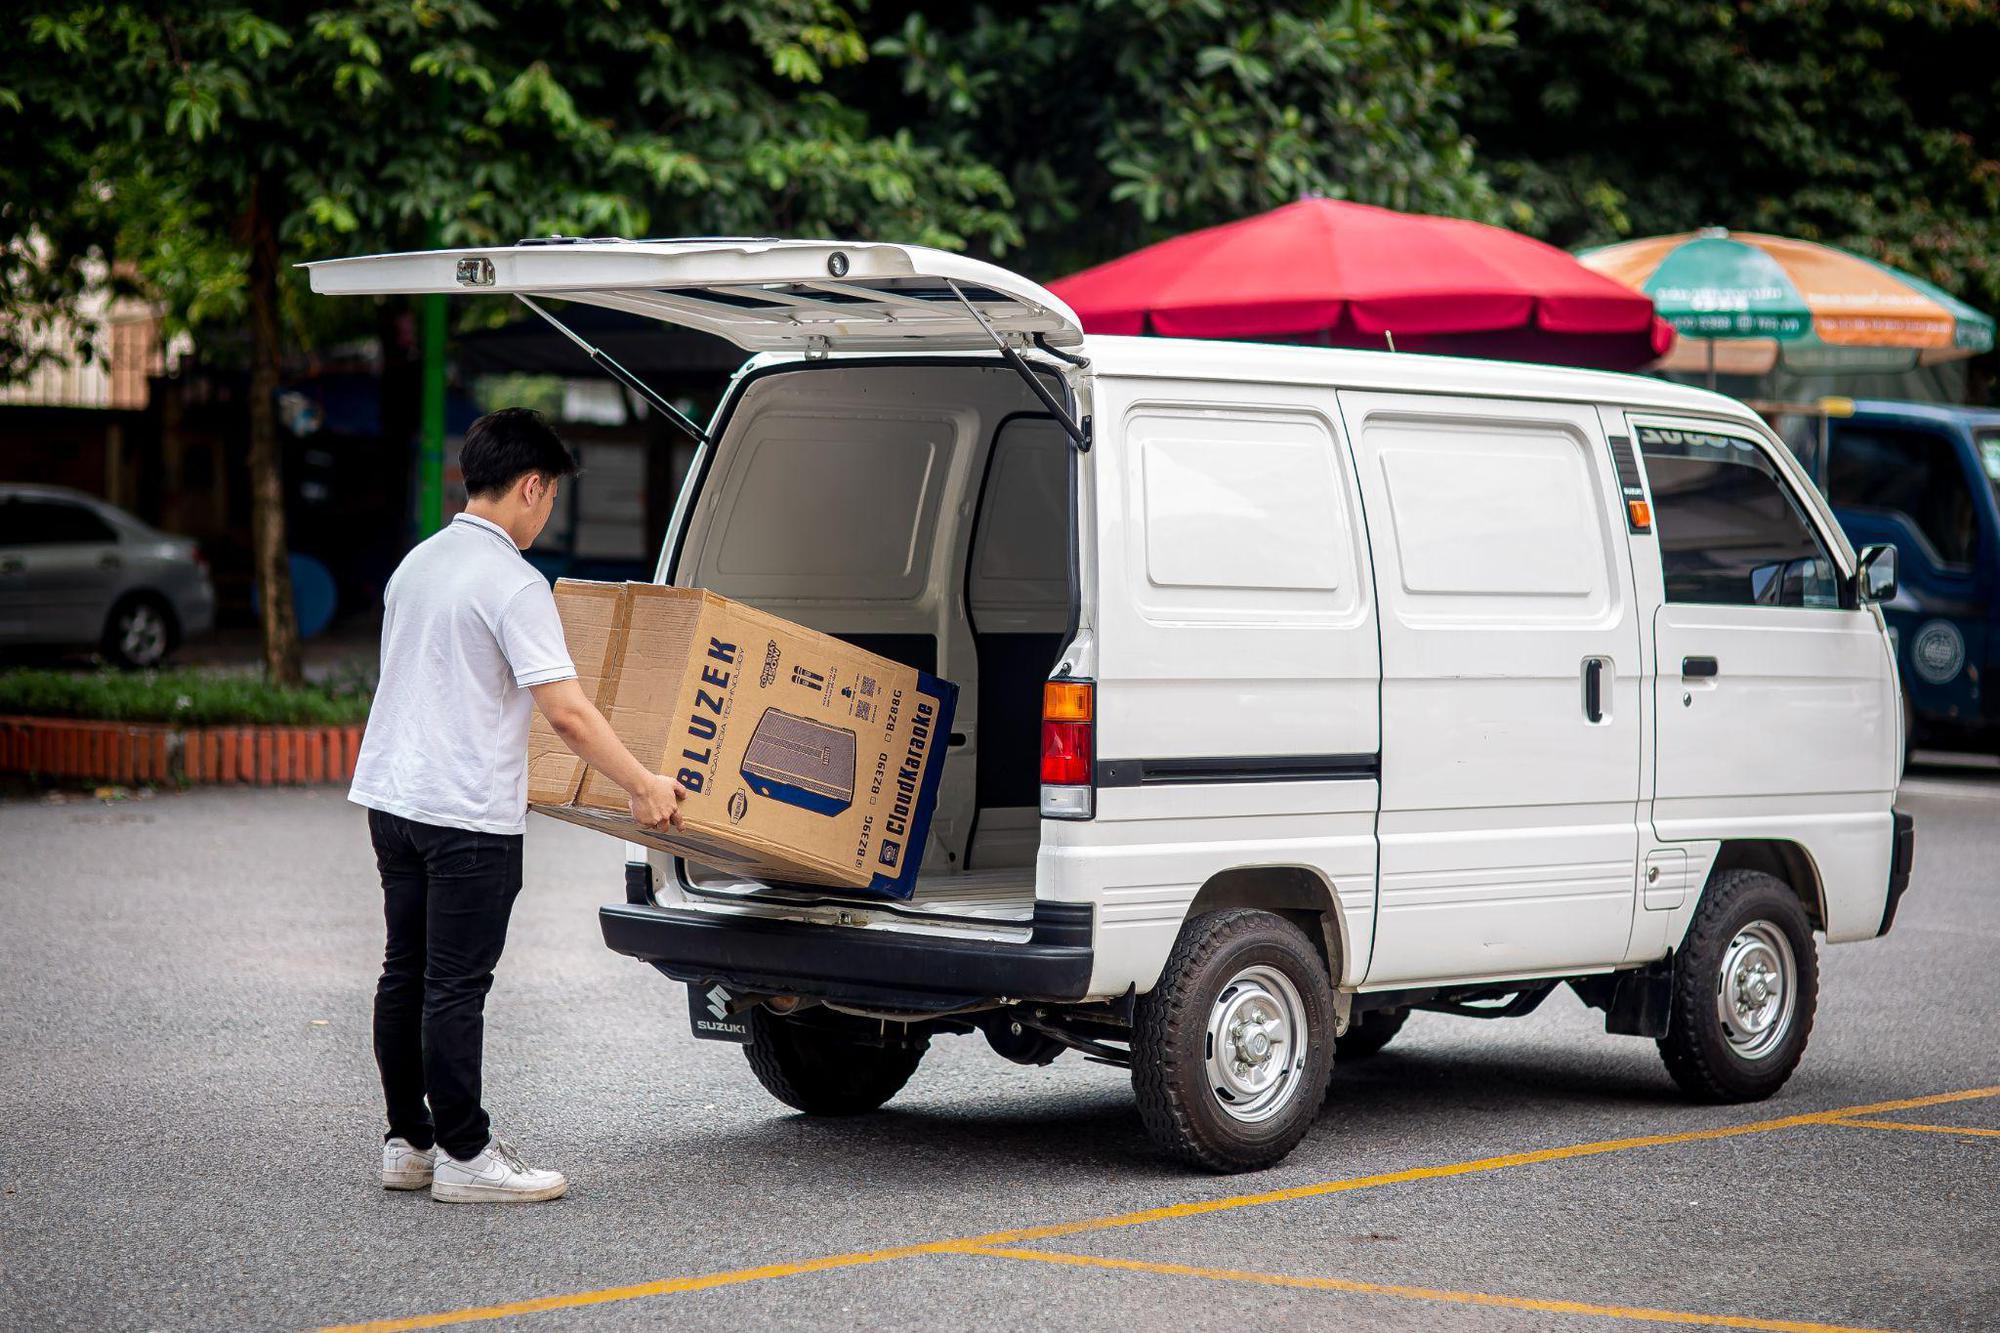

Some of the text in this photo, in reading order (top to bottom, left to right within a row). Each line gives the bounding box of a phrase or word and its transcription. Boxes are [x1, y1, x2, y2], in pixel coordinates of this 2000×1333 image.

[724, 647, 744, 718] TECHNOLOGY
[676, 637, 736, 793] BLUZEK
[886, 689, 902, 731] BZ88G
[871, 753, 887, 794] BZ39D
[886, 703, 933, 836] CloudKaraoke
[857, 815, 873, 856] BZ39G
[697, 1020, 746, 1034] SUZUKI
